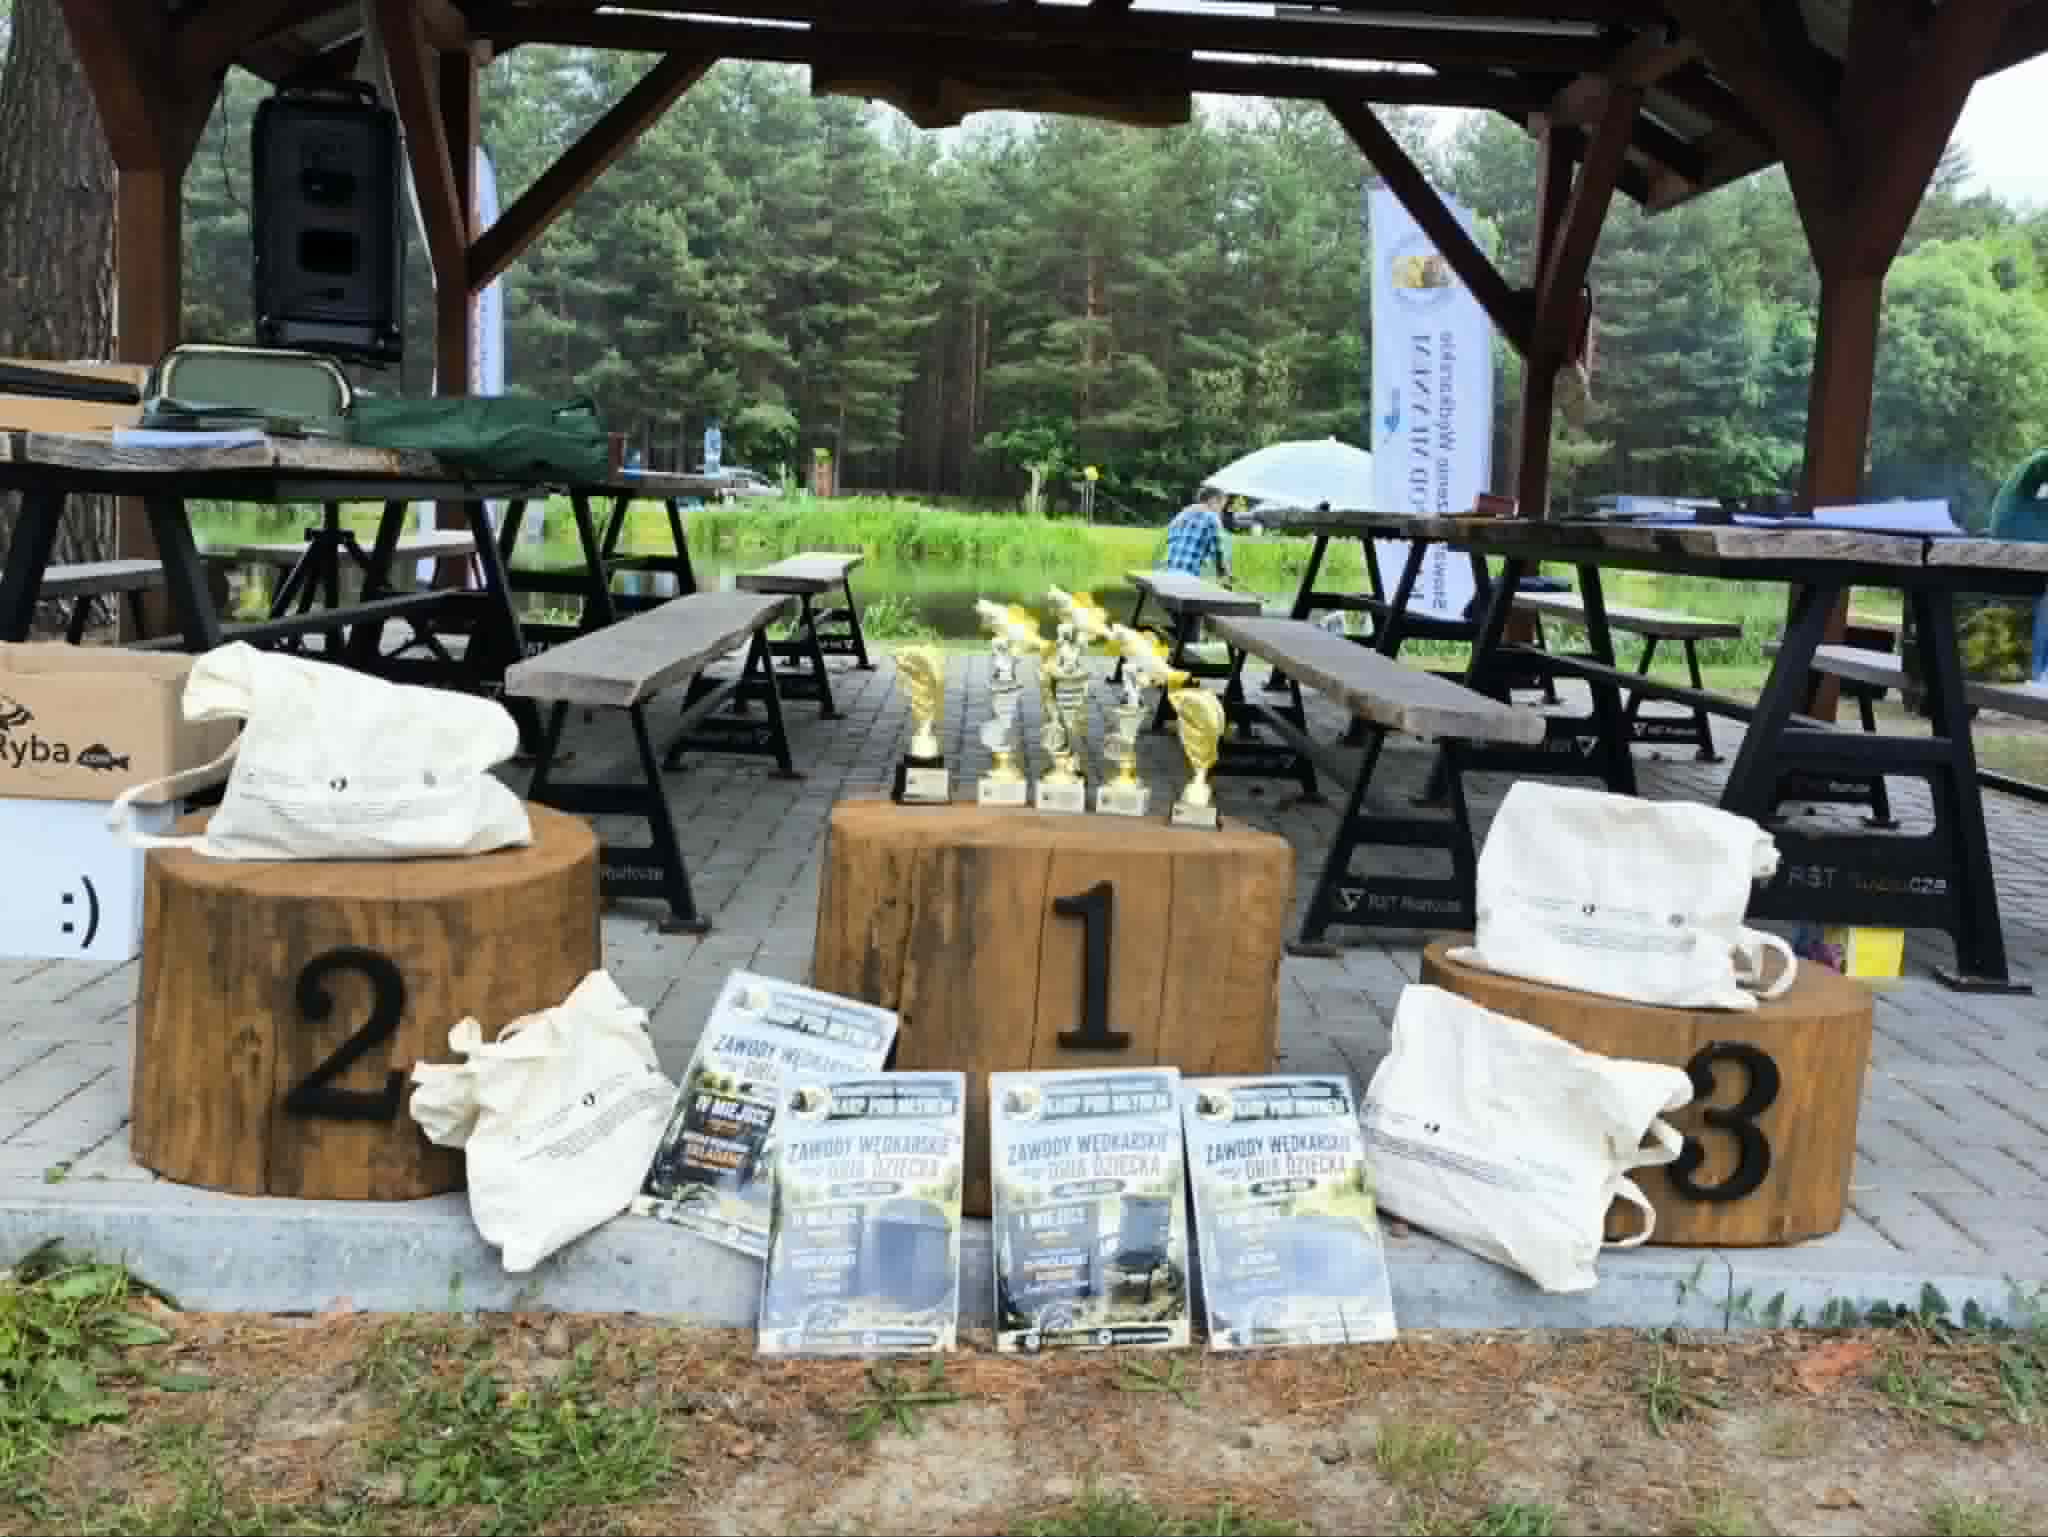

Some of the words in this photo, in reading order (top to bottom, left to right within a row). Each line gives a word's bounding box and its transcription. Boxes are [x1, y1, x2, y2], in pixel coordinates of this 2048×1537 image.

[286, 946, 406, 1121] 2
[1052, 879, 1133, 1050] 1
[1008, 1136, 1072, 1166] ZAWODY
[1204, 1137, 1265, 1166] ZAWODY
[1667, 1041, 1782, 1204] 3
